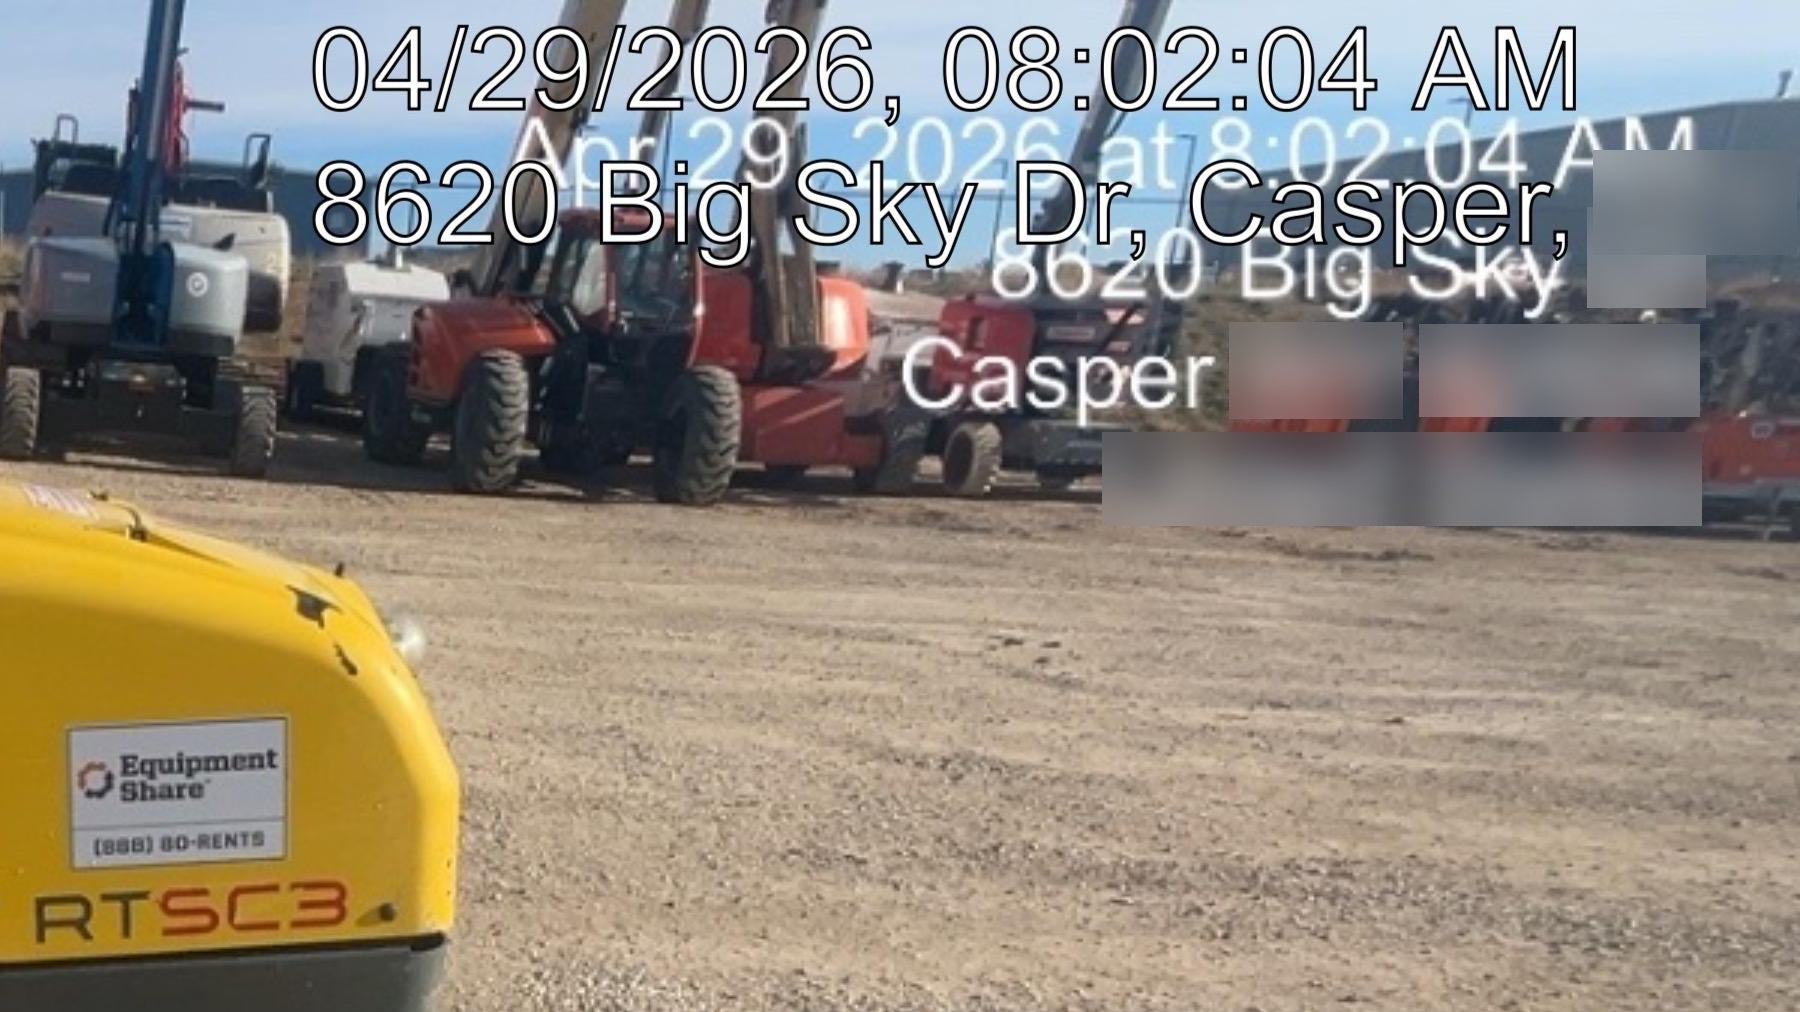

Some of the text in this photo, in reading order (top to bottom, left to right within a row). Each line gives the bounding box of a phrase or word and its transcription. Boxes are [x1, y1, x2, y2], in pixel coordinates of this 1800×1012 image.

[119, 749, 279, 780] Equipment
[119, 780, 204, 802] Share
[93, 830, 265, 856] (888) 80-RENTS
[35, 880, 348, 944] RTSC3
